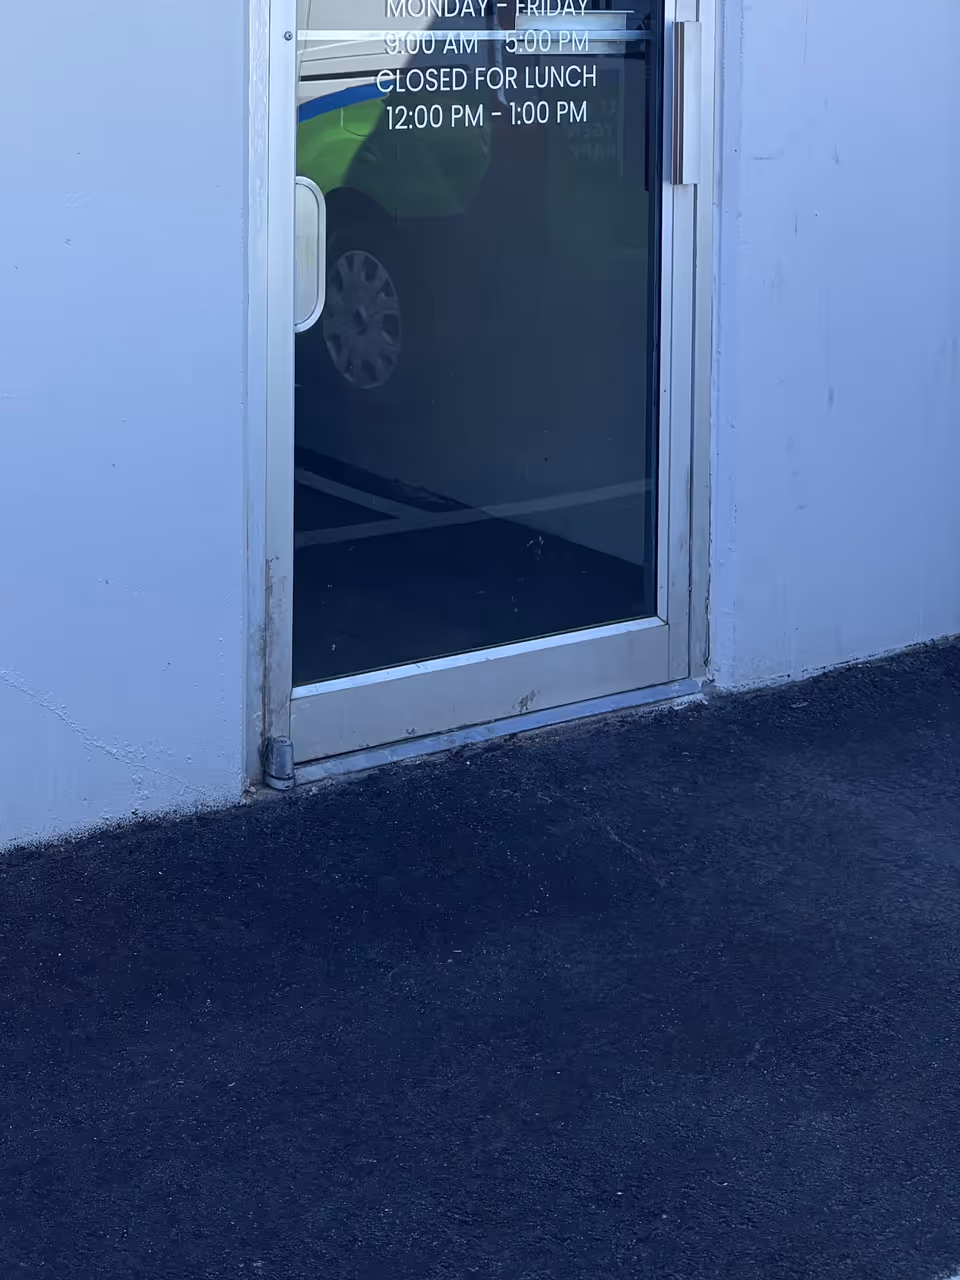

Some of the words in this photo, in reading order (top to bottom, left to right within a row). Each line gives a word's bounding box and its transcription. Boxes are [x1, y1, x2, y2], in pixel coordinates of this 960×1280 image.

[385, 31, 435, 54] 9:00
[443, 31, 479, 54] AM
[505, 30, 552, 53] 5:00
[558, 30, 590, 52] PM
[376, 67, 467, 93] CLOSED
[475, 67, 517, 91] FOR
[525, 65, 597, 89] LUNCH
[386, 105, 443, 130] 12:00
[451, 104, 484, 128] PM
[509, 101, 550, 126] 1:00
[557, 100, 588, 124] PM
